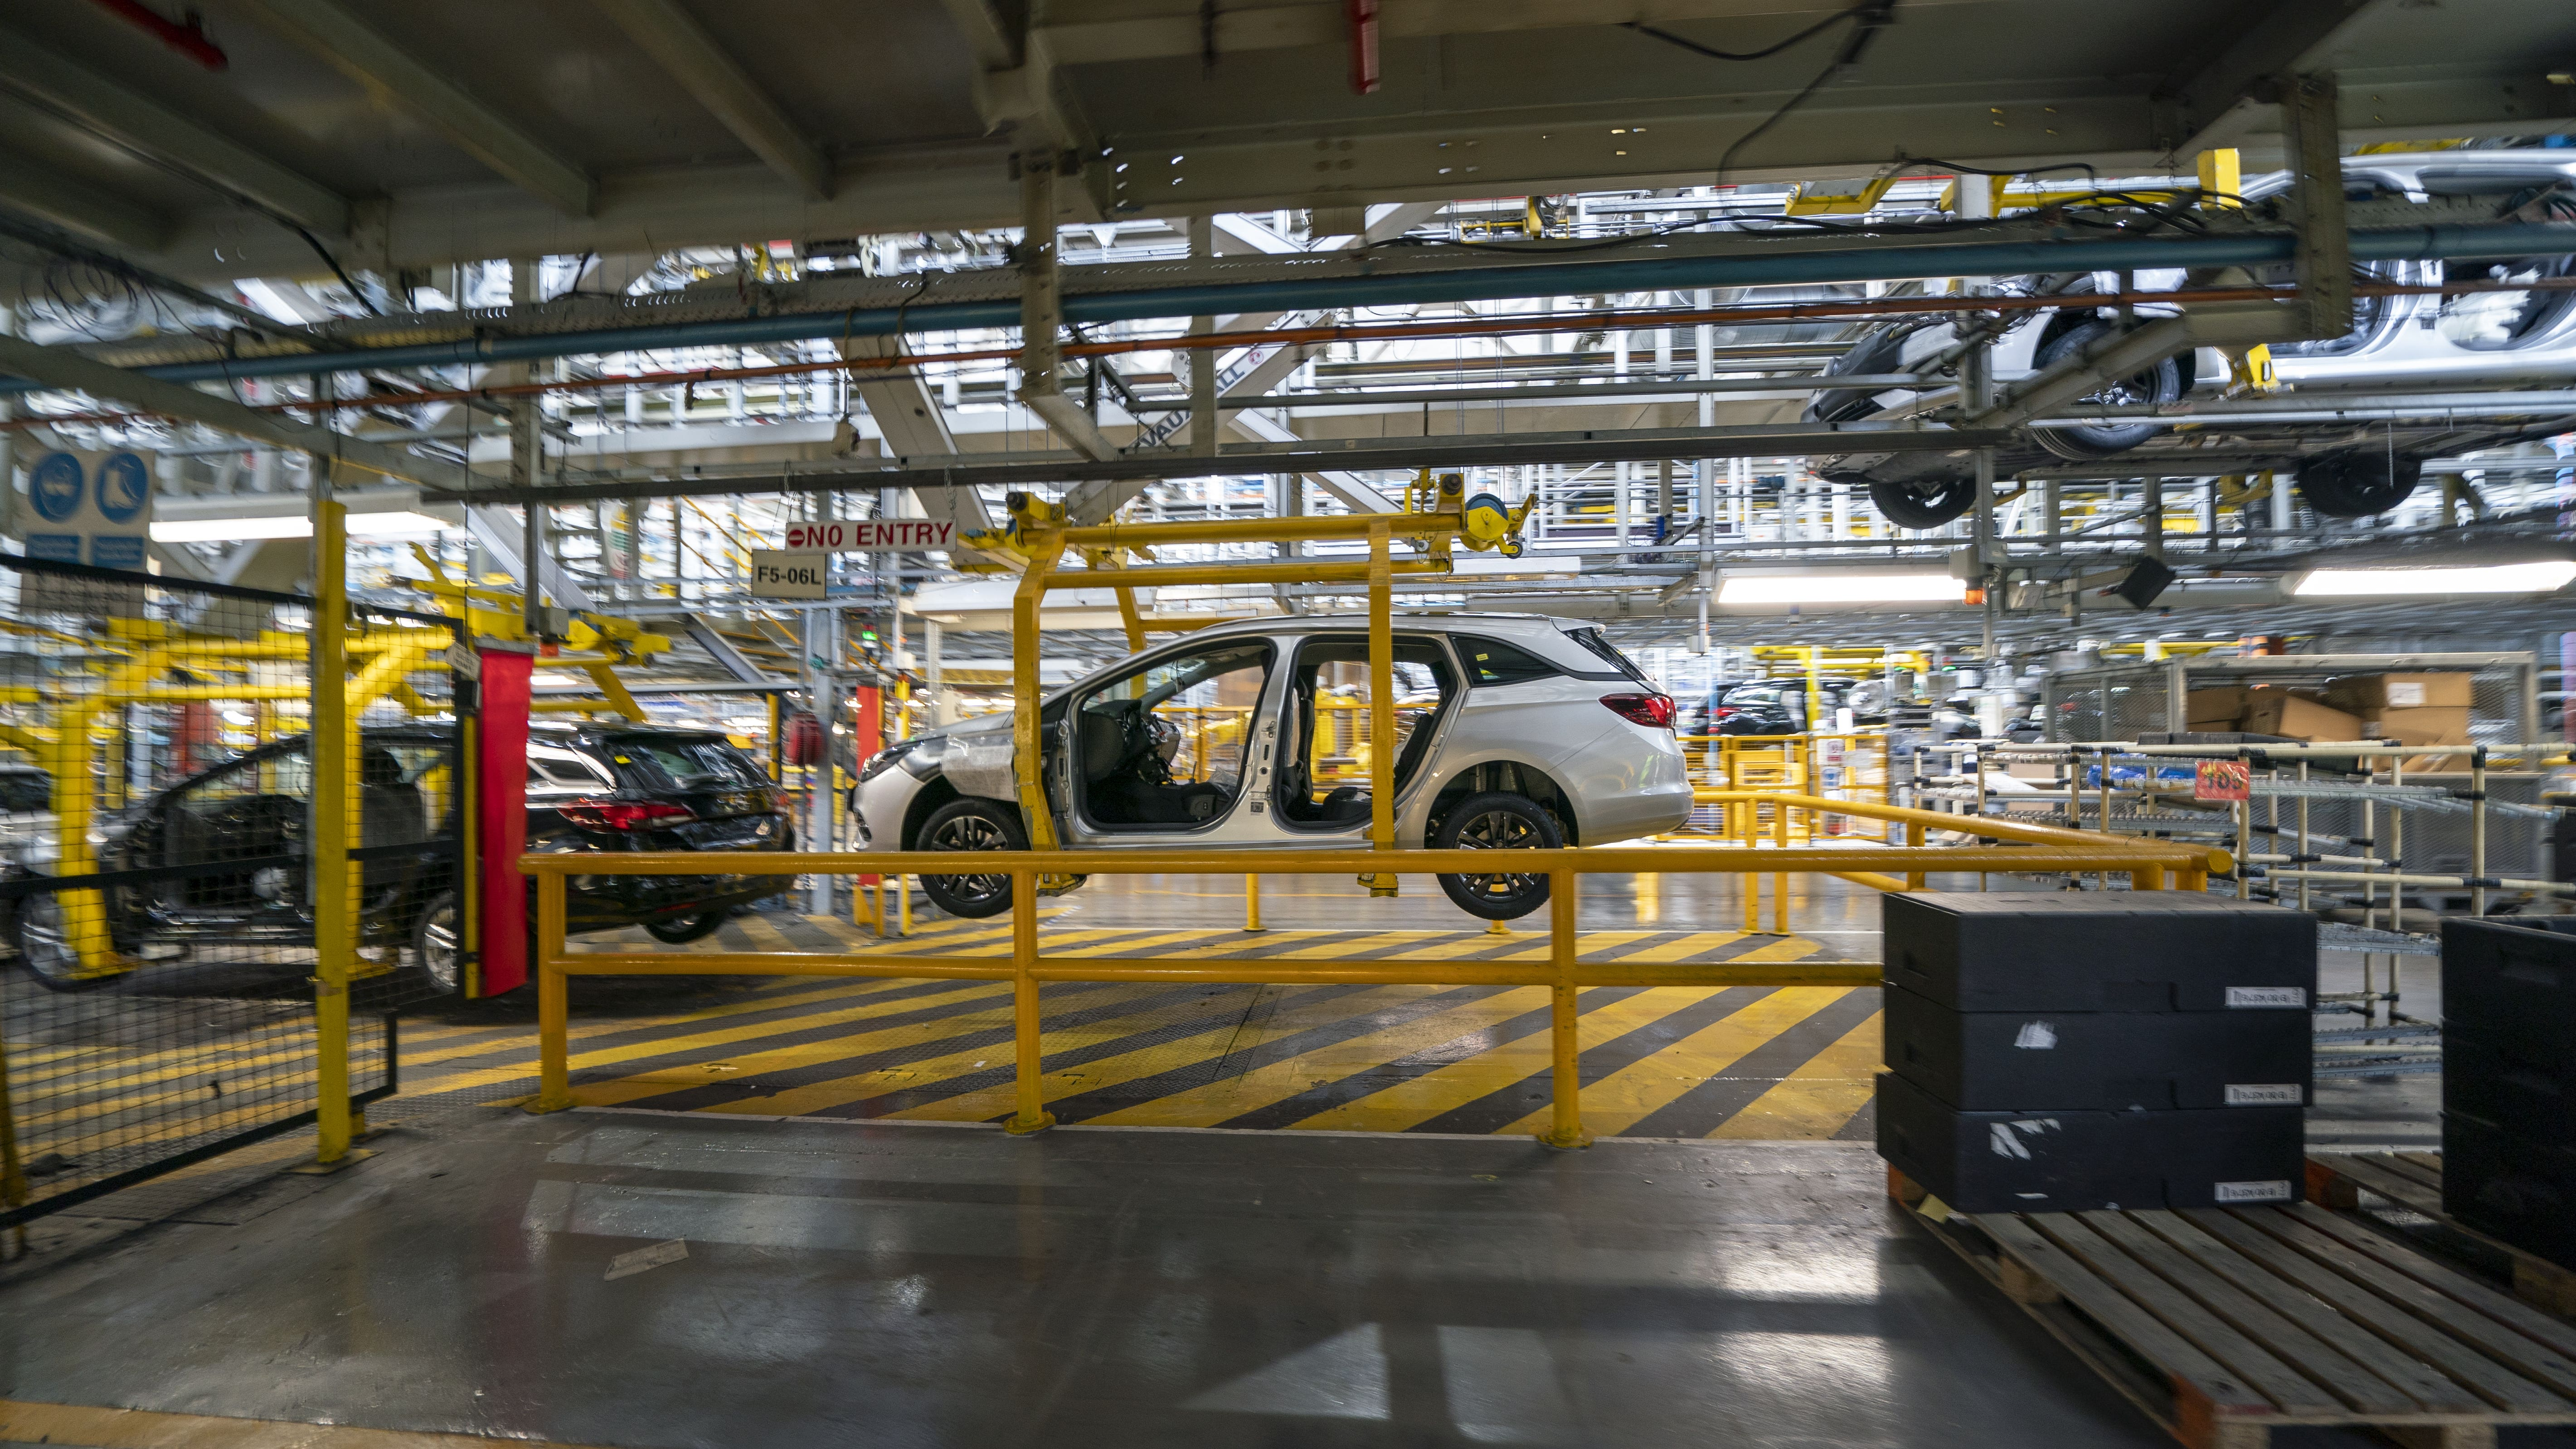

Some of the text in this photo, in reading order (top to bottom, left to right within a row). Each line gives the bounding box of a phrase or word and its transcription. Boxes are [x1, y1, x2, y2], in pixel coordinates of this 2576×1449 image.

[1141, 367, 1245, 447] VAULL
[807, 522, 953, 548] NO ENTRY
[757, 566, 821, 585] F5-06L
